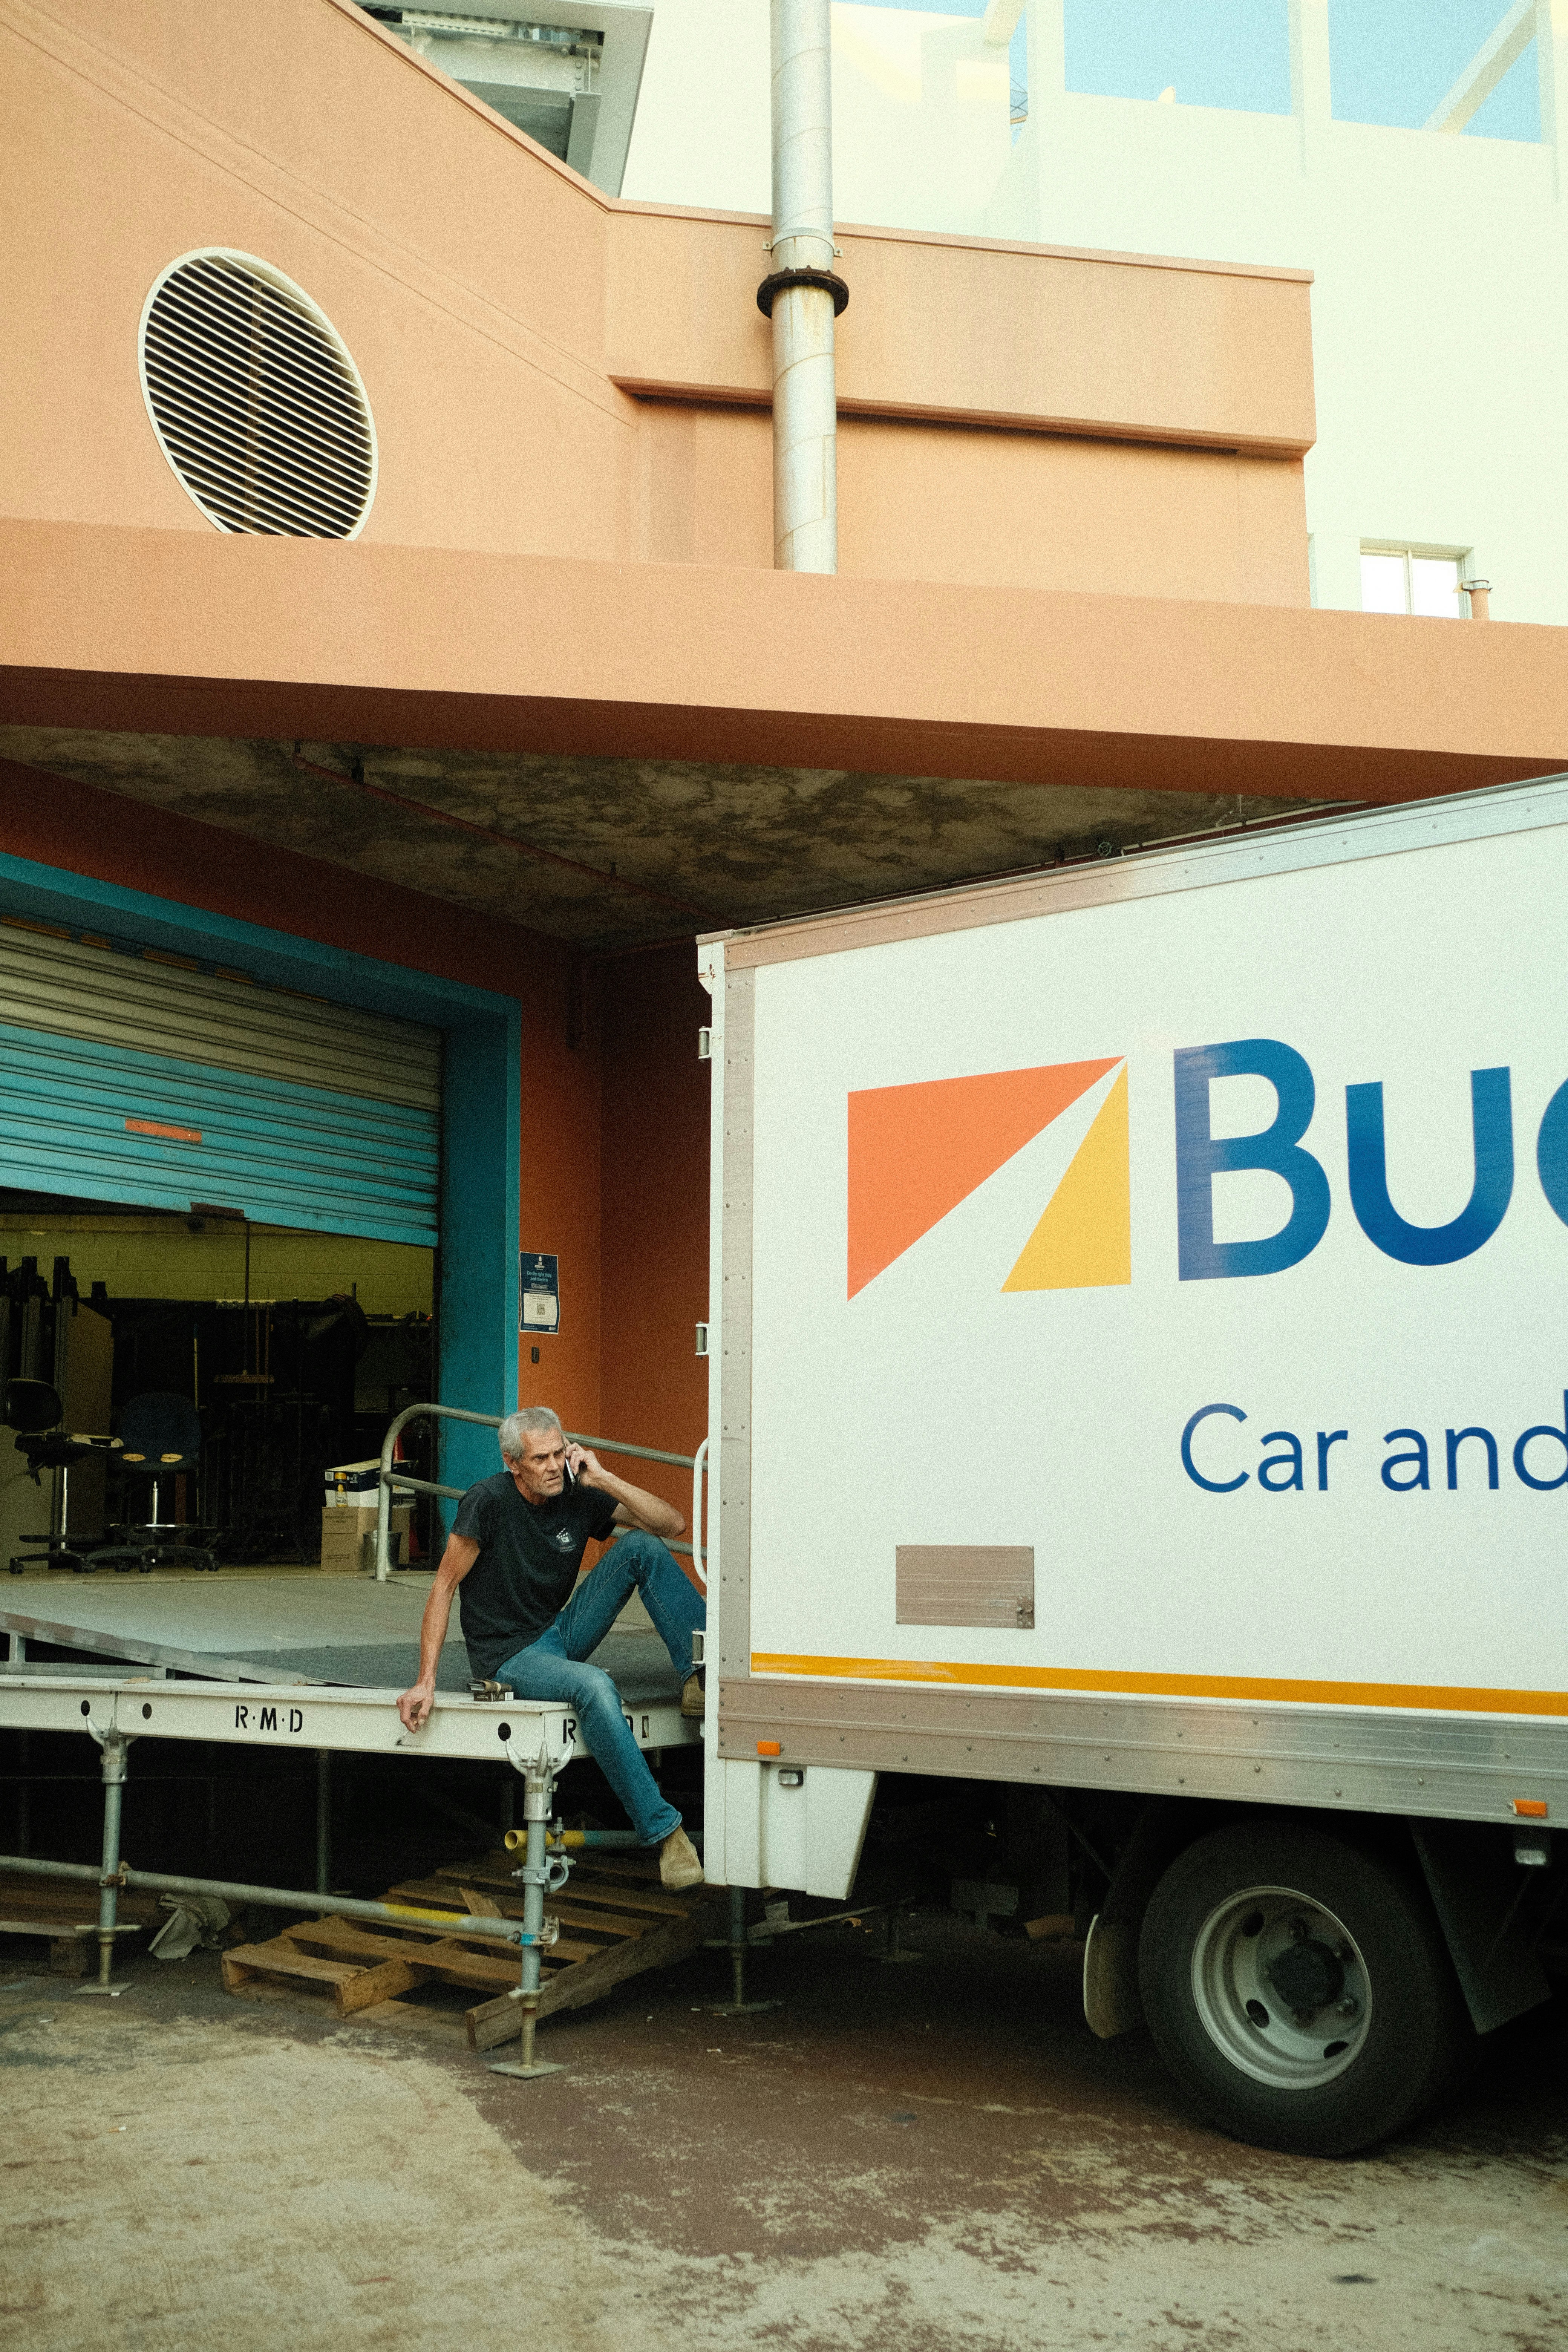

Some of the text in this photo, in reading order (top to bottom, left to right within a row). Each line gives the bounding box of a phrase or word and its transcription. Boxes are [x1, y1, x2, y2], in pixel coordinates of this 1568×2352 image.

[1173, 1038, 1568, 1282] Bu
[1181, 1389, 1568, 1493] Car and
